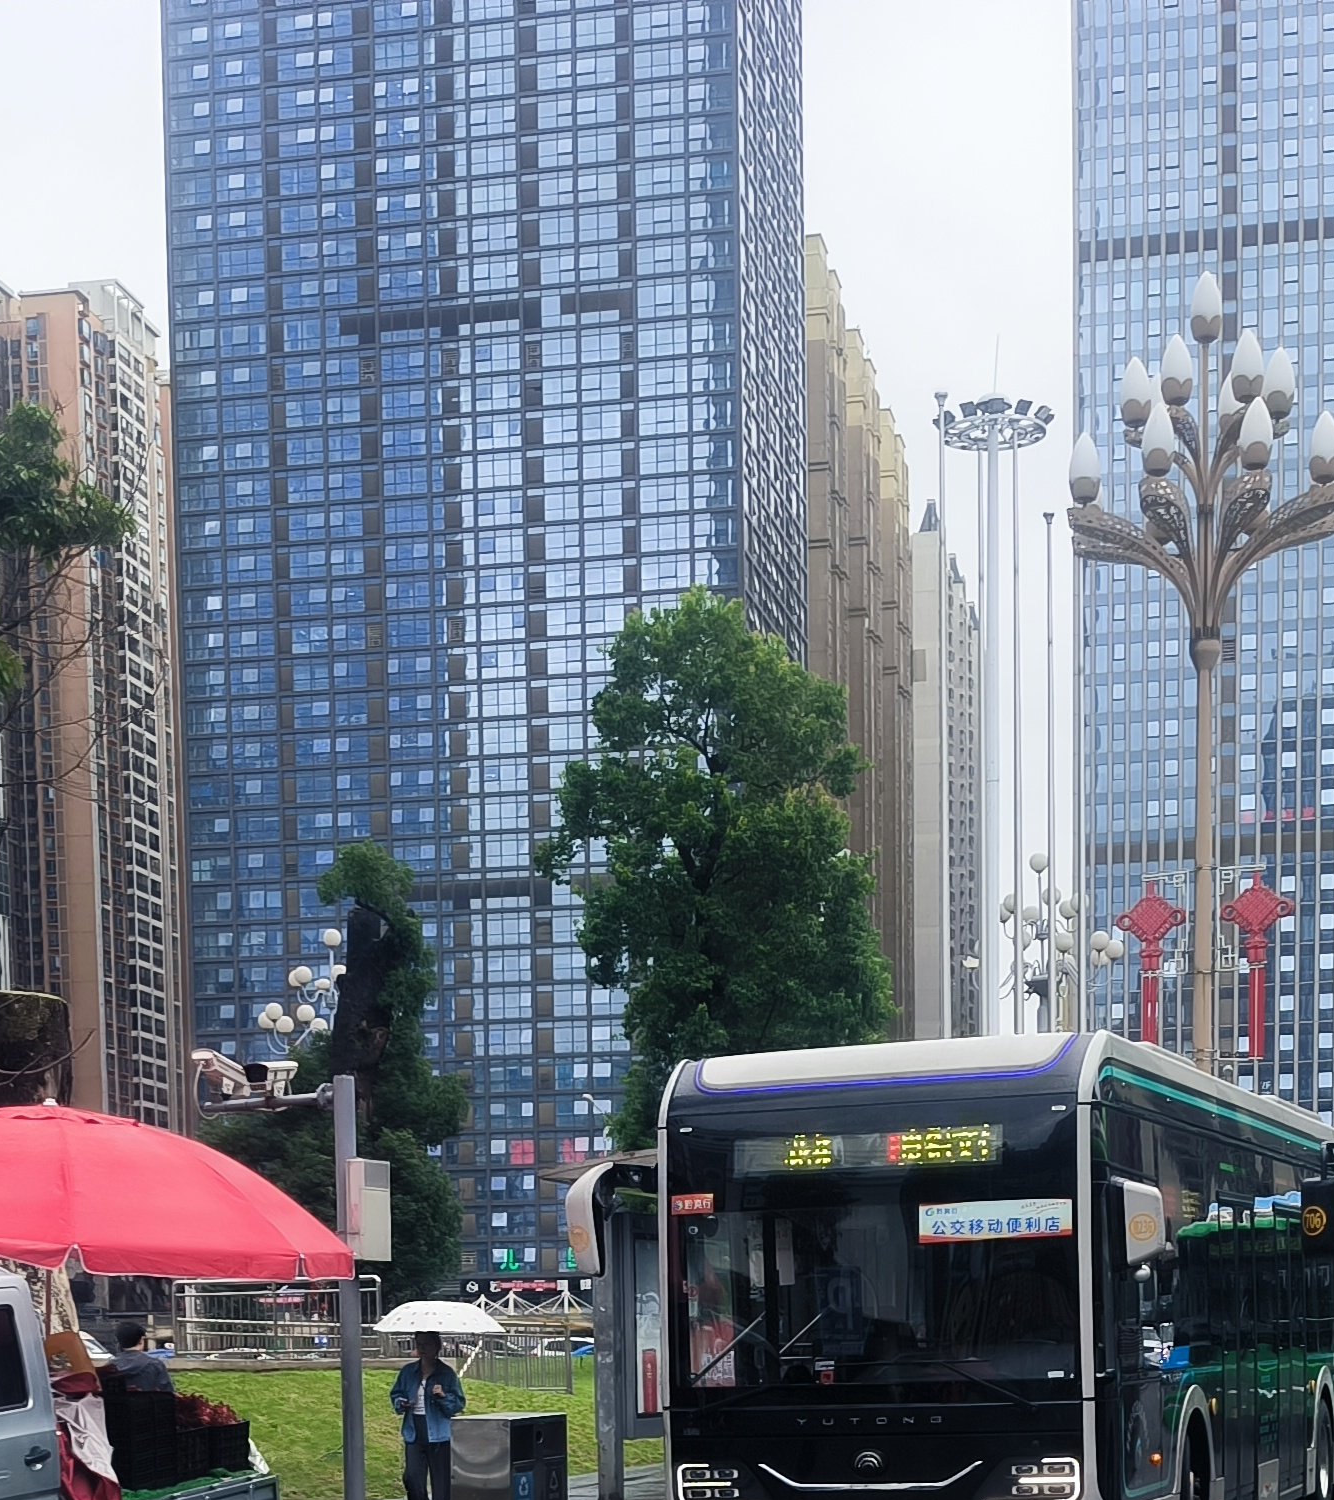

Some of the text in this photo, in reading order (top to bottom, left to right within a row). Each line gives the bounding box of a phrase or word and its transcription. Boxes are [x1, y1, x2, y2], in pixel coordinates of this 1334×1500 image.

[931, 1215, 1061, 1236] 公交移动便利店
[1305, 1213, 1321, 1228] 706
[796, 1415, 942, 1426] YUTONG
